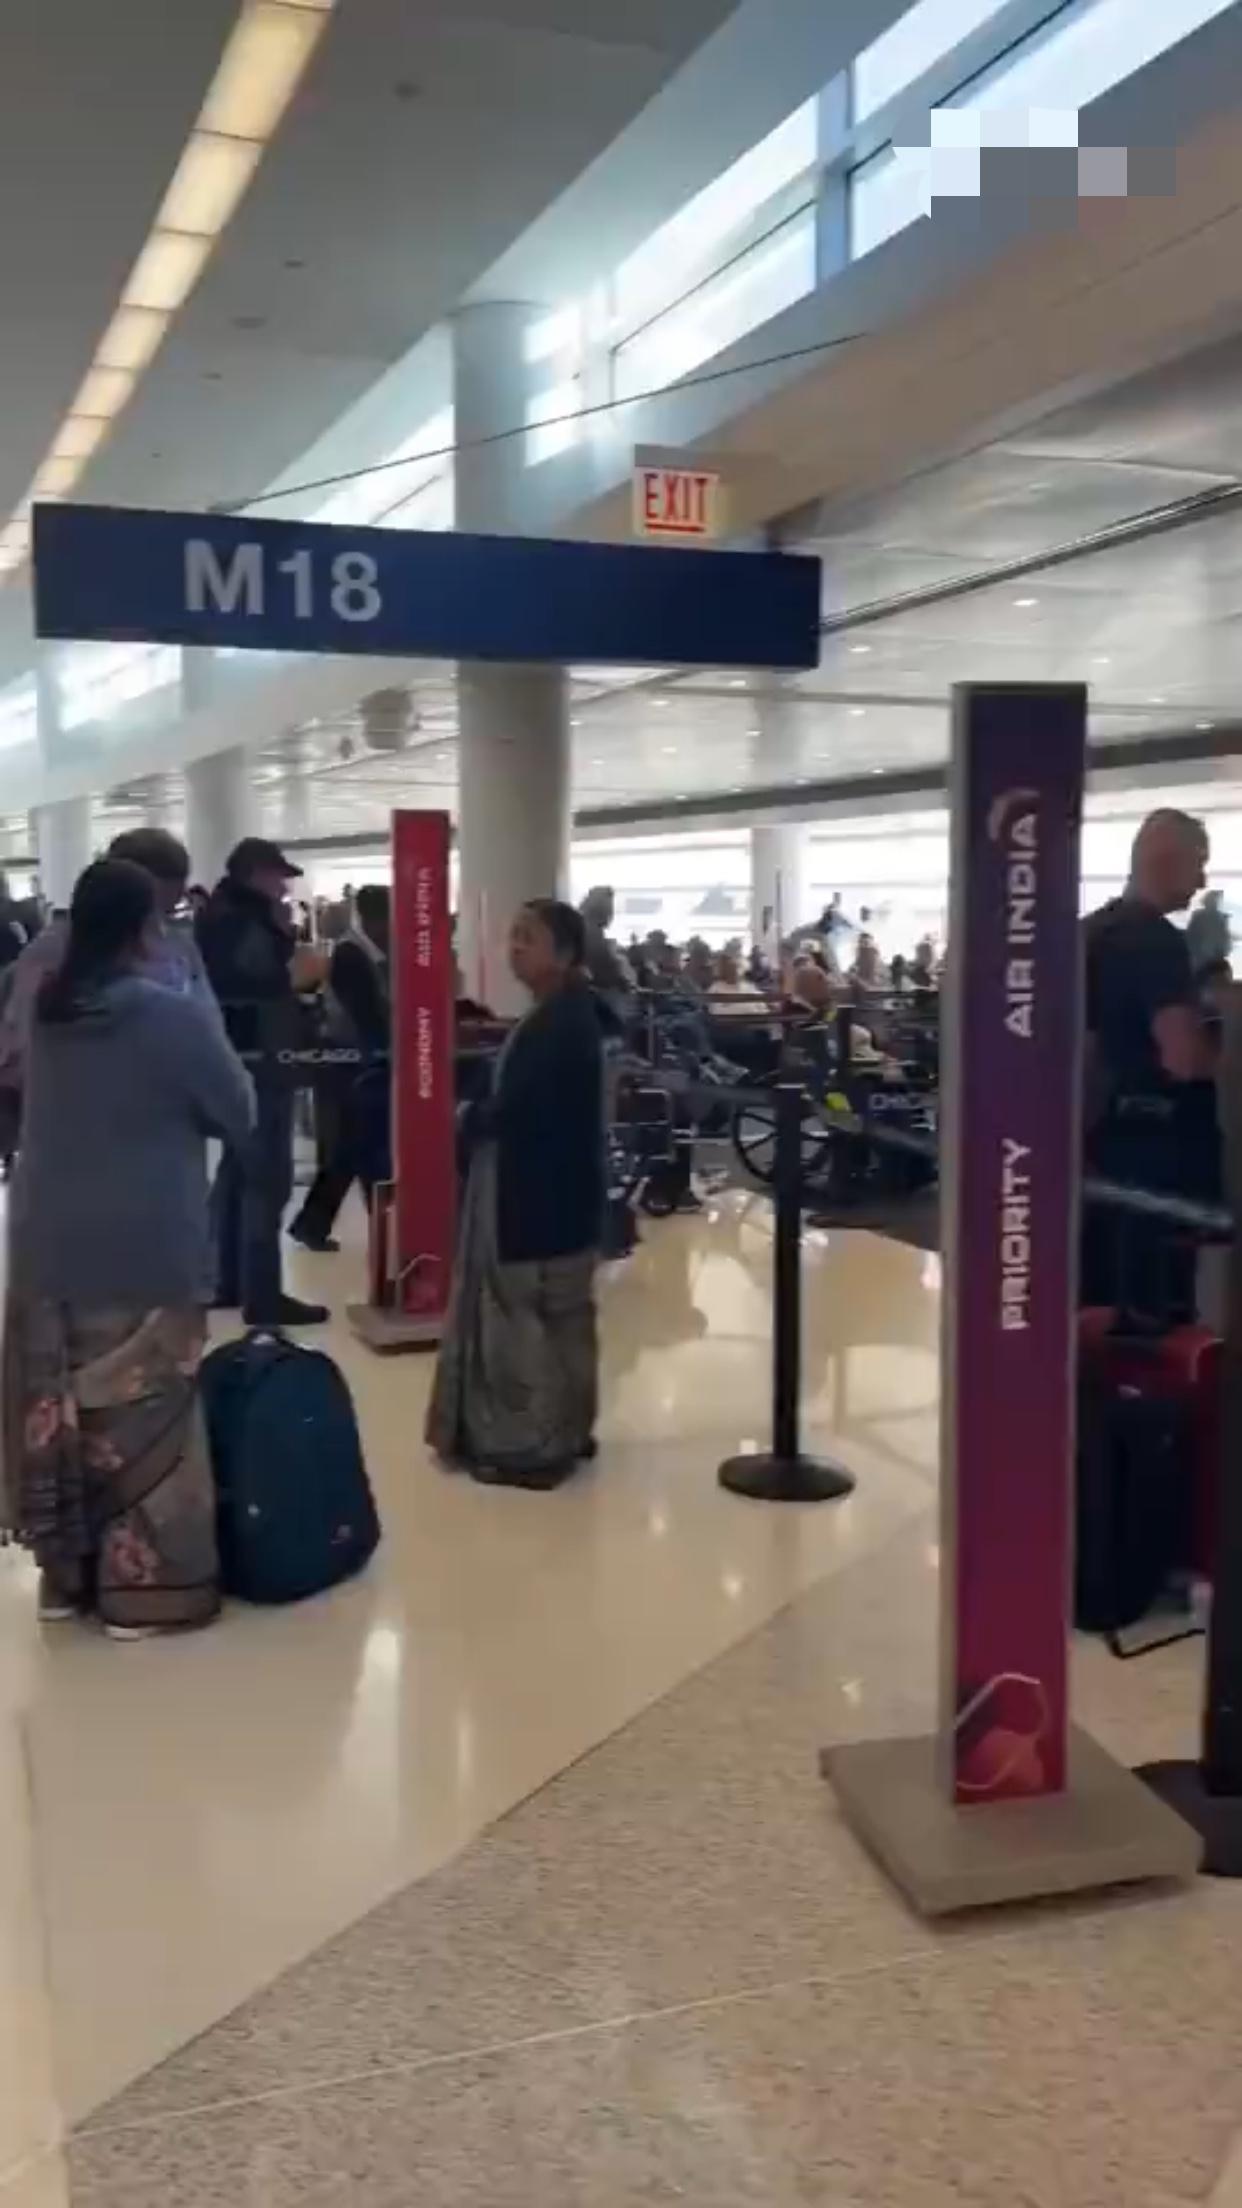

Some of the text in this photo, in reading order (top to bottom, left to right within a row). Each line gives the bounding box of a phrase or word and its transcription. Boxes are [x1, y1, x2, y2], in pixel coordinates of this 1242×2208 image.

[643, 472, 710, 525] EXIT
[184, 539, 383, 622] M18
[1003, 812, 1040, 1039] AIR INDIA
[277, 1047, 362, 1063] CHICAGO
[417, 1006, 433, 1099] ECONOMY
[1001, 1138, 1033, 1331] PRIORITY
